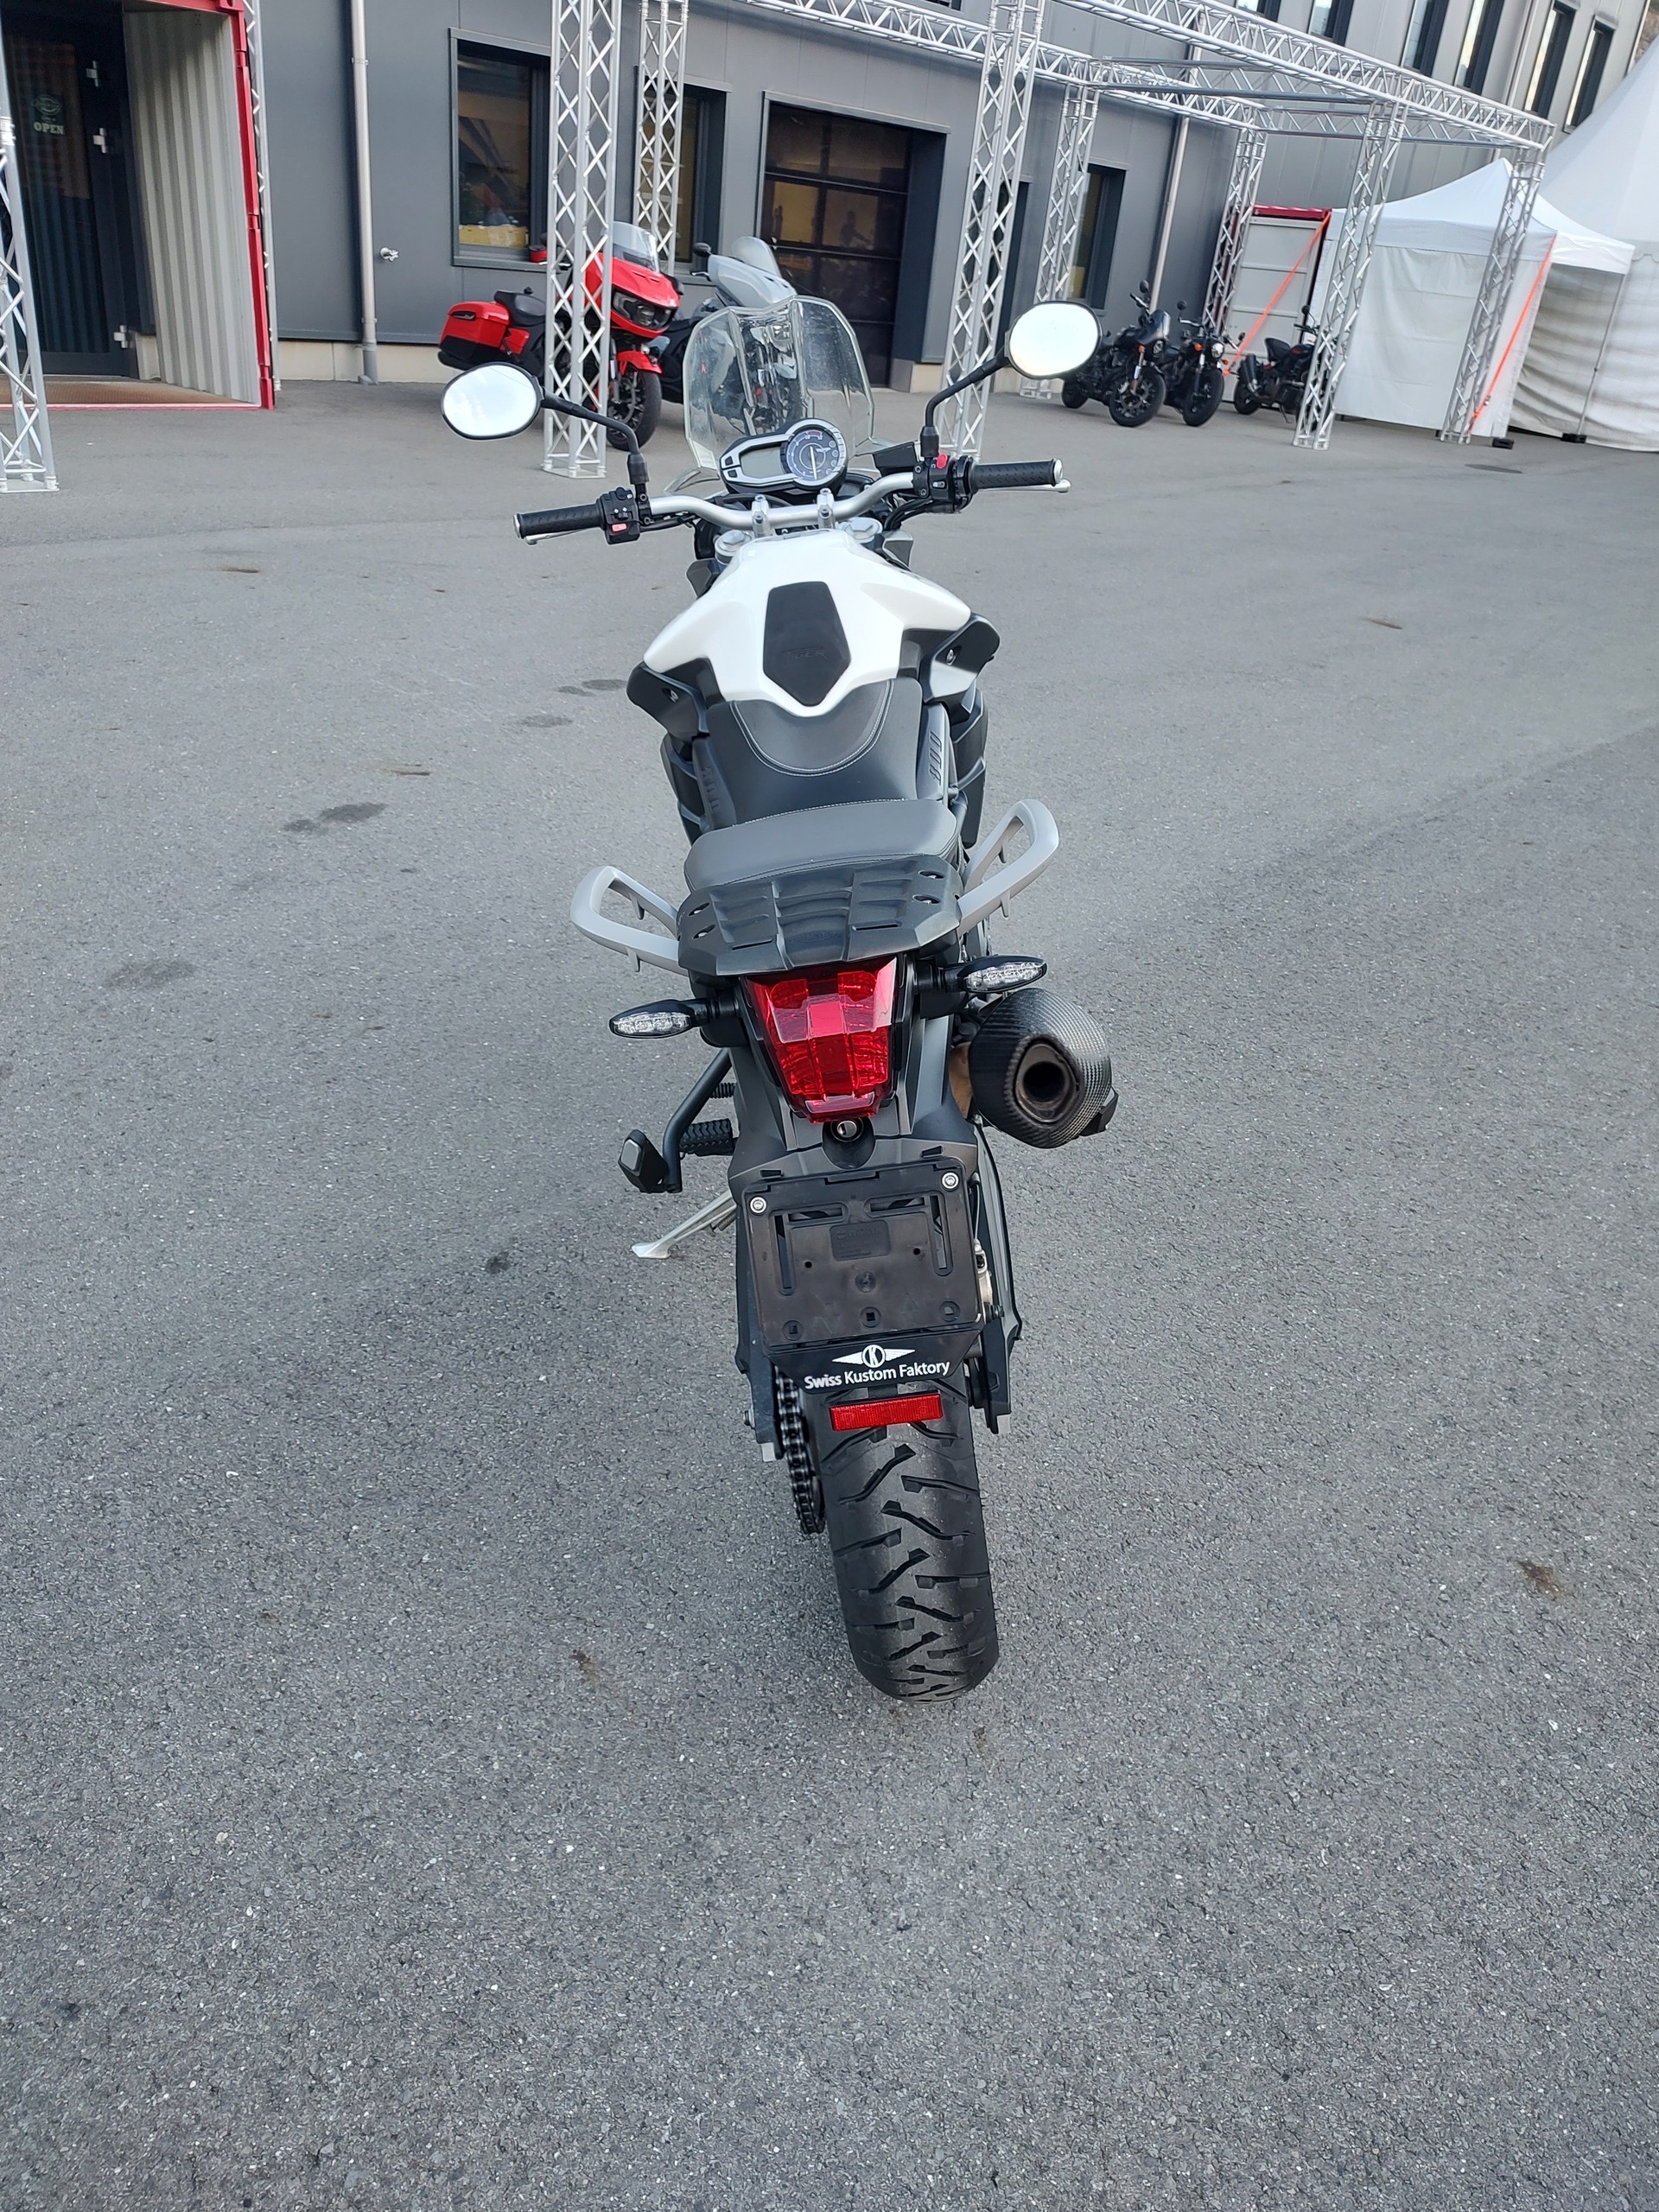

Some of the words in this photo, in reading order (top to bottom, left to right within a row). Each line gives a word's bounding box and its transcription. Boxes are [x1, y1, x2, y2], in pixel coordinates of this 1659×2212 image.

[33, 121, 65, 135] OPEN
[804, 1374, 842, 1389] Swiss
[844, 1367, 897, 1384] Kustom
[899, 1361, 950, 1378] Faktory
